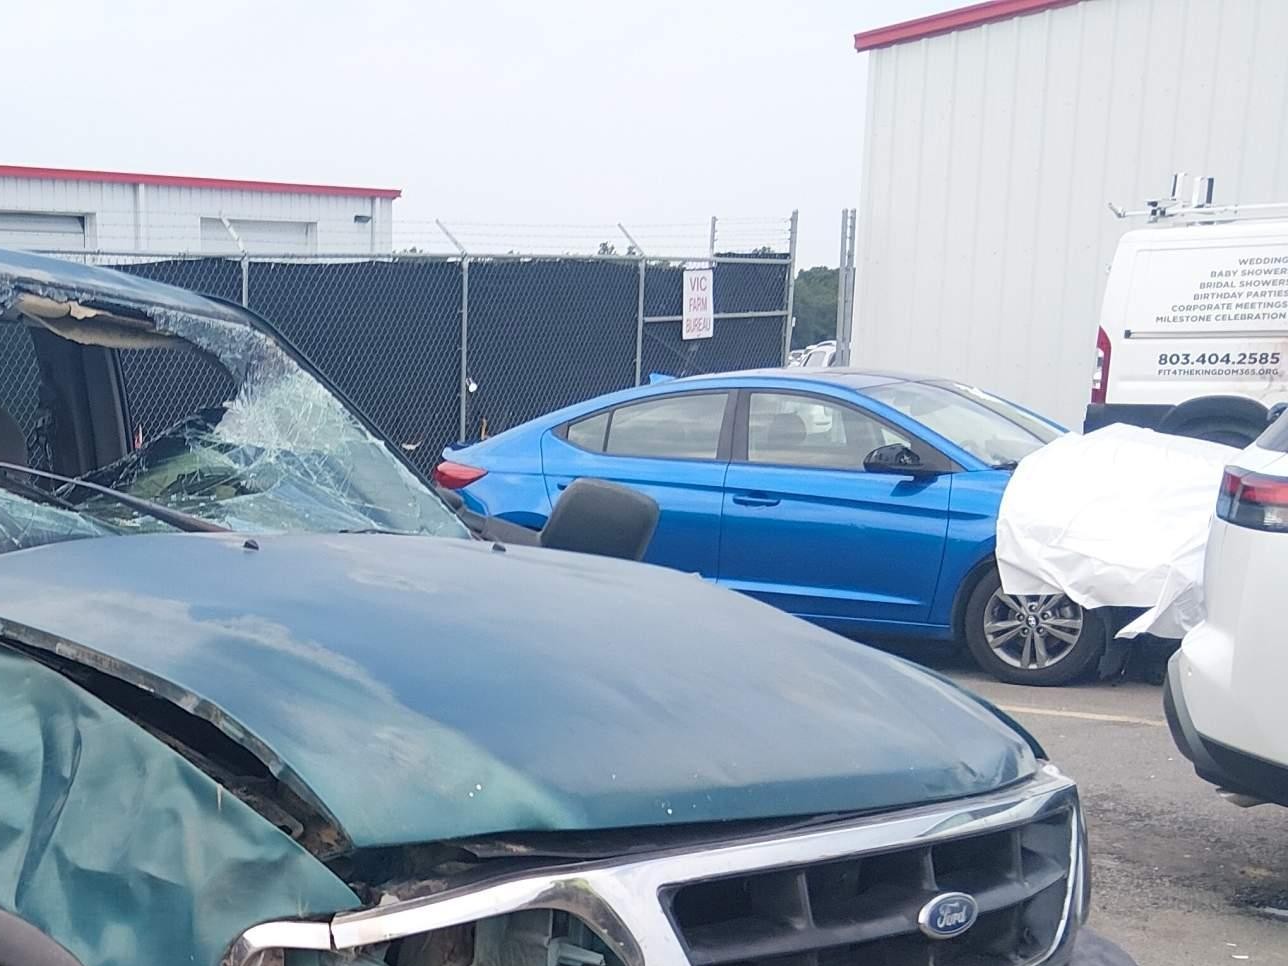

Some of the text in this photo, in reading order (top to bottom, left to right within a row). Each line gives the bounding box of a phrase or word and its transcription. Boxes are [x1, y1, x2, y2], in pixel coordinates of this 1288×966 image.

[1210, 267, 1288, 278] BABY SHOWER
[689, 276, 707, 292] VIC
[1199, 282, 1236, 290] BRIDAL
[1193, 289, 1288, 301] BIRTHDAY PARTIES
[688, 296, 708, 312] FARM
[1171, 300, 1288, 313] CORPORATE MEETINGS
[1155, 312, 1286, 324] MILESTONE CELEBRATION
[685, 317, 711, 334] BUREAU
[1158, 352, 1280, 365] 803.404.2585
[1158, 368, 1279, 377] FIT4THEKINGDOM365.ORG
[936, 902, 967, 928] Ford
